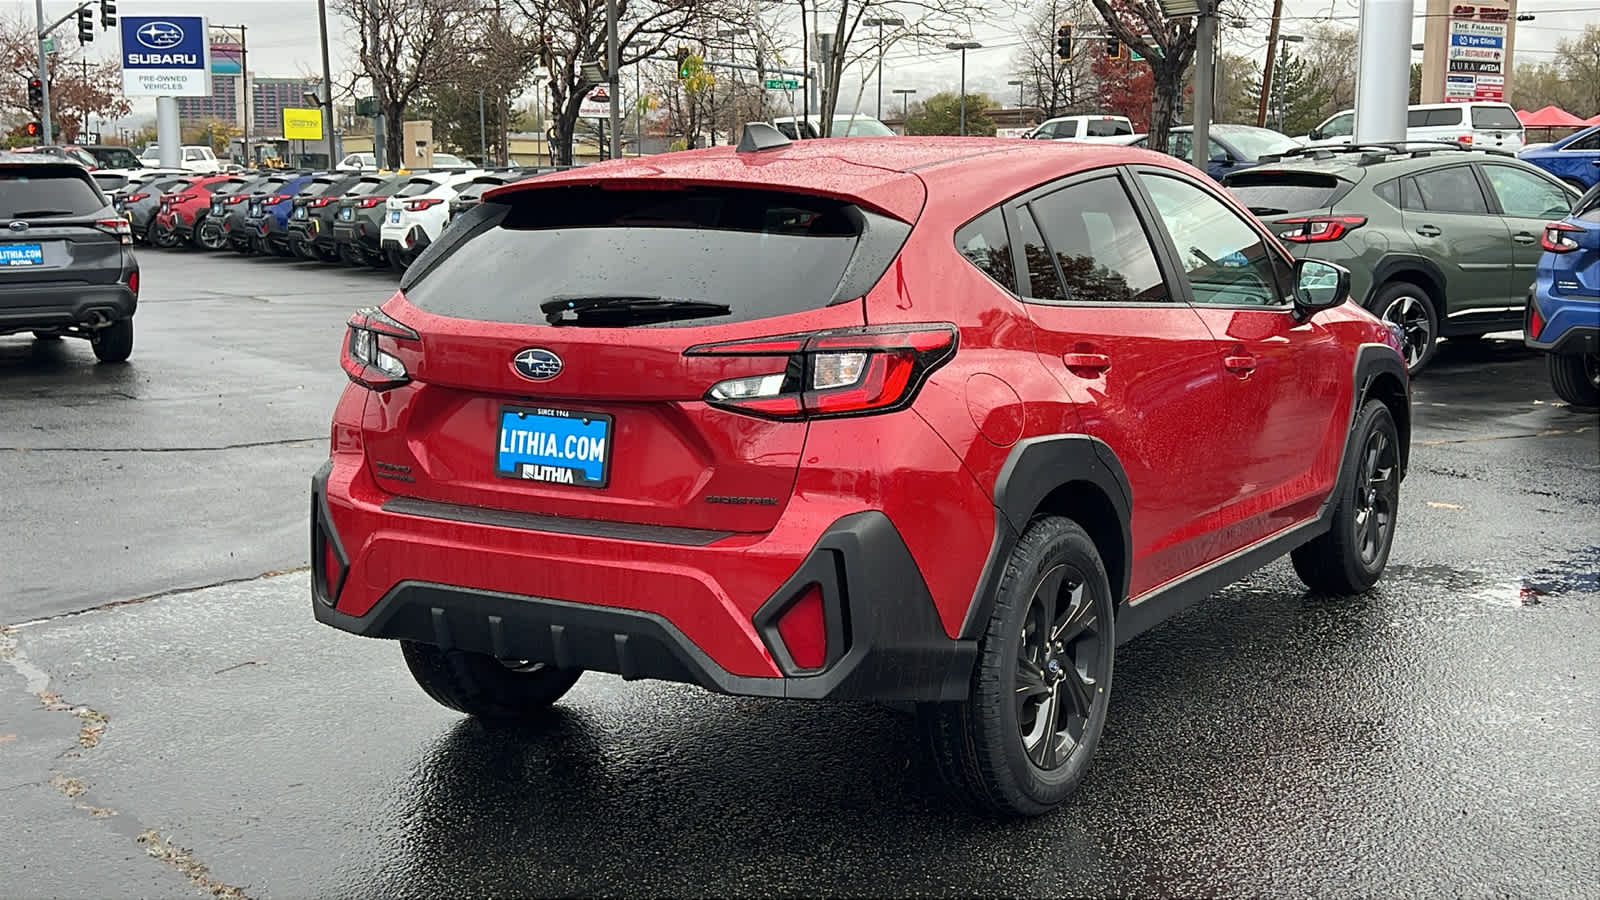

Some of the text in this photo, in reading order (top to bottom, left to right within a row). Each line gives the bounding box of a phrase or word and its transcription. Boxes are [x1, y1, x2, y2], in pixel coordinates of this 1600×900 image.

[1471, 23, 1503, 31] FRAMERY
[1469, 36, 1479, 46] Eye
[128, 53, 197, 65] SUBARU
[1451, 62, 1475, 70] AURA
[537, 408, 555, 416] SINCE
[500, 427, 606, 463] LITHIA.COM
[534, 465, 574, 484] LITHIA
